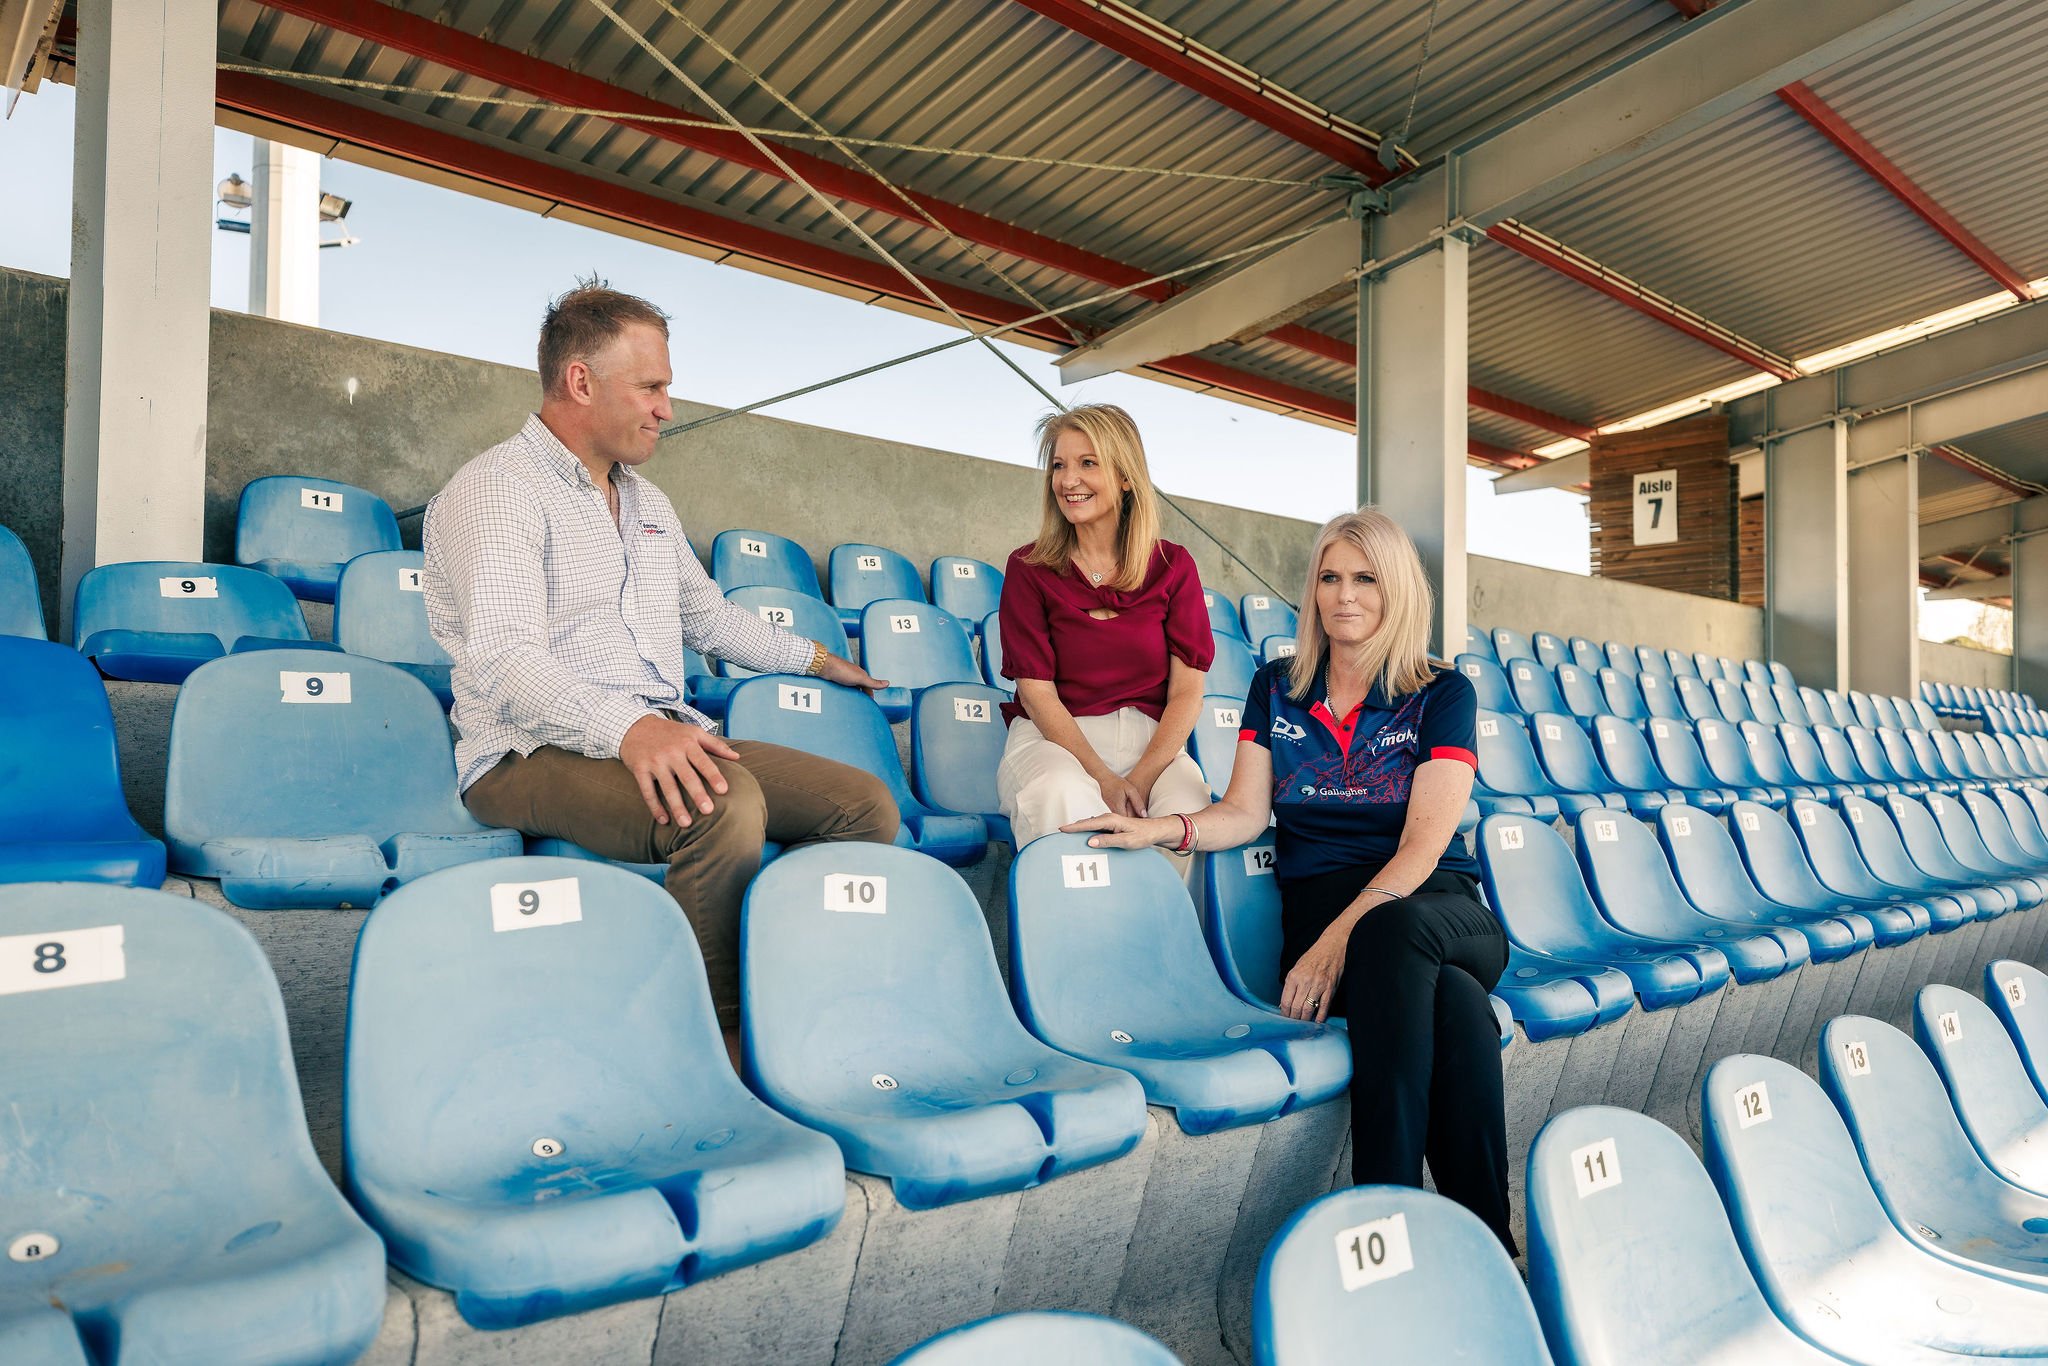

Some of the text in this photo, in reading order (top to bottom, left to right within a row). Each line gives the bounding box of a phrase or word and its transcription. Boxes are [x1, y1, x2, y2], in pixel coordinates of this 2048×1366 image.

[1639, 479, 1672, 495] Aisle
[311, 494, 331, 507] 11
[1647, 498, 1663, 529] 7
[747, 543, 761, 553] 14
[863, 558, 876, 567] 15
[958, 567, 969, 576] 16
[181, 580, 196, 594] 9
[410, 573, 418, 586] 1
[767, 611, 785, 623] 12
[896, 619, 912, 630] 13
[306, 677, 324, 697] 9
[790, 691, 812, 708] 11
[964, 704, 983, 719] 12
[1220, 712, 1234, 724] 14
[1483, 723, 1492, 734] 17
[1319, 787, 1368, 797] Gallagher
[1599, 823, 1612, 837] 15
[1676, 821, 1687, 833] 16
[1504, 830, 1519, 845] 14
[1254, 851, 1273, 869] 12
[1076, 862, 1100, 881] 11
[843, 881, 875, 904] 10
[518, 890, 540, 915] 9
[33, 942, 67, 974] 8
[2008, 985, 2020, 1001] 15
[1942, 1016, 1956, 1037] 14
[1115, 1033, 1128, 1042] 11
[1849, 1046, 1865, 1070] 13
[875, 1078, 894, 1089] 10
[1742, 1090, 1763, 1118] 12
[542, 1145, 553, 1154] 9
[1584, 1151, 1607, 1183] 11
[1350, 1231, 1386, 1270] 10
